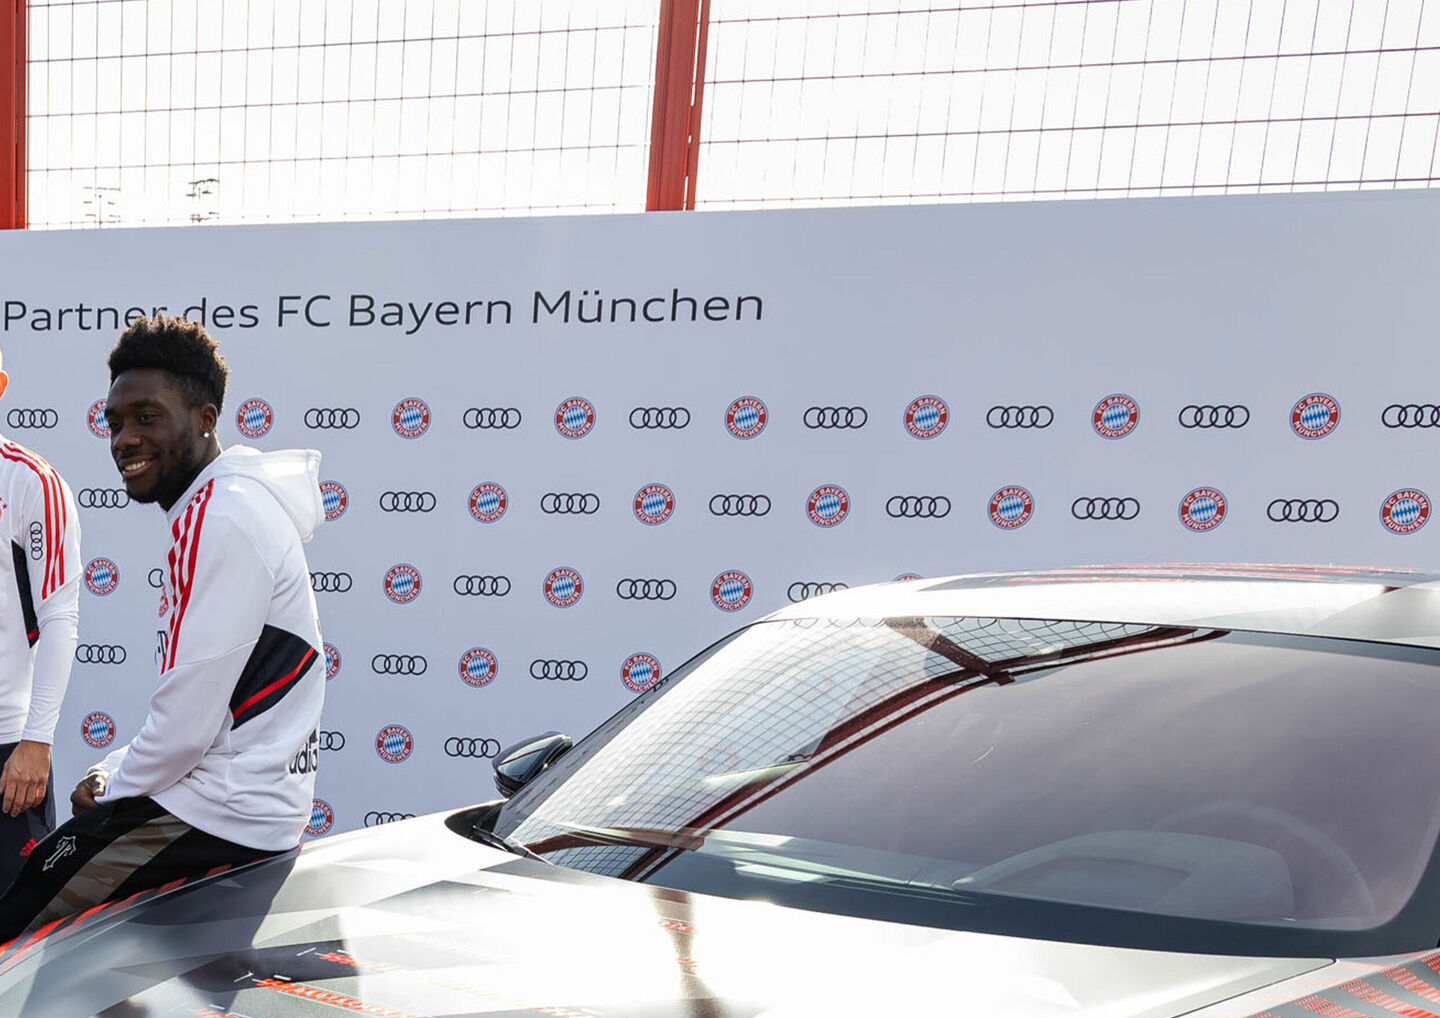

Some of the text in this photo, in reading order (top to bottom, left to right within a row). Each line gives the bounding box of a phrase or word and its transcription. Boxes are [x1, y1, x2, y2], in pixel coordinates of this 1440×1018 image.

[278, 295, 330, 328] FC
[349, 294, 511, 335] Bayern
[533, 288, 762, 324] München
[558, 400, 592, 415] FC BAYERN
[728, 399, 764, 415] FC BAYERN
[907, 398, 946, 414] FC BAYERN
[1095, 397, 1136, 414] FC BAYERN
[1294, 396, 1336, 413] FC BAYERN
[321, 483, 345, 498] BAYERN
[637, 486, 671, 501] FC BAYERN
[810, 487, 846, 503] FC BAYERN
[992, 489, 1030, 505] FC BAYERN
[1183, 489, 1224, 506] FC BAYERN
[1384, 492, 1427, 509] FC BAYERN
[326, 504, 344, 519] CHEN
[546, 570, 580, 585] FC BAYERN
[714, 573, 750, 588] FC BAYERN
[323, 644, 338, 660] YERN
[623, 655, 658, 670] FC BAYERN
[313, 801, 331, 815] AYERN
